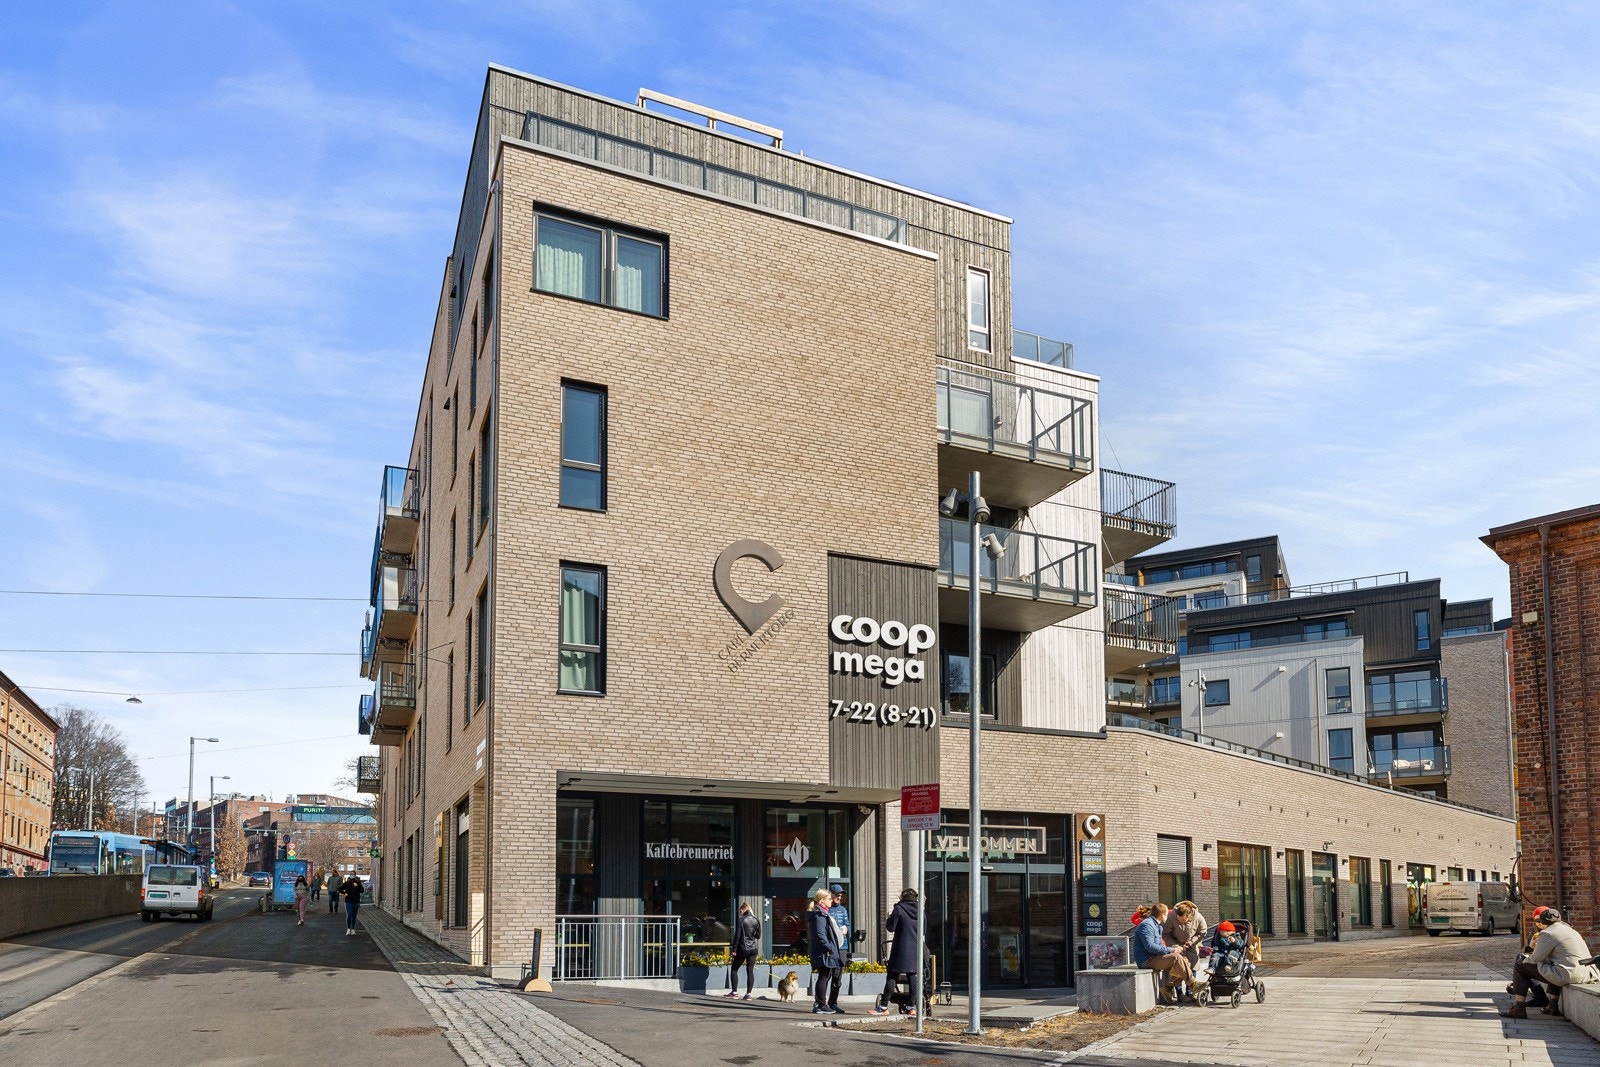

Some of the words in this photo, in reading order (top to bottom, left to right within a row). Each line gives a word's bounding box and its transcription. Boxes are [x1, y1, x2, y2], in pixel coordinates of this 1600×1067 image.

[831, 614, 936, 654] coop
[833, 651, 925, 686] mega
[645, 842, 734, 860] Kaffebrenneriet
[936, 835, 1037, 852] VELOMMEN
